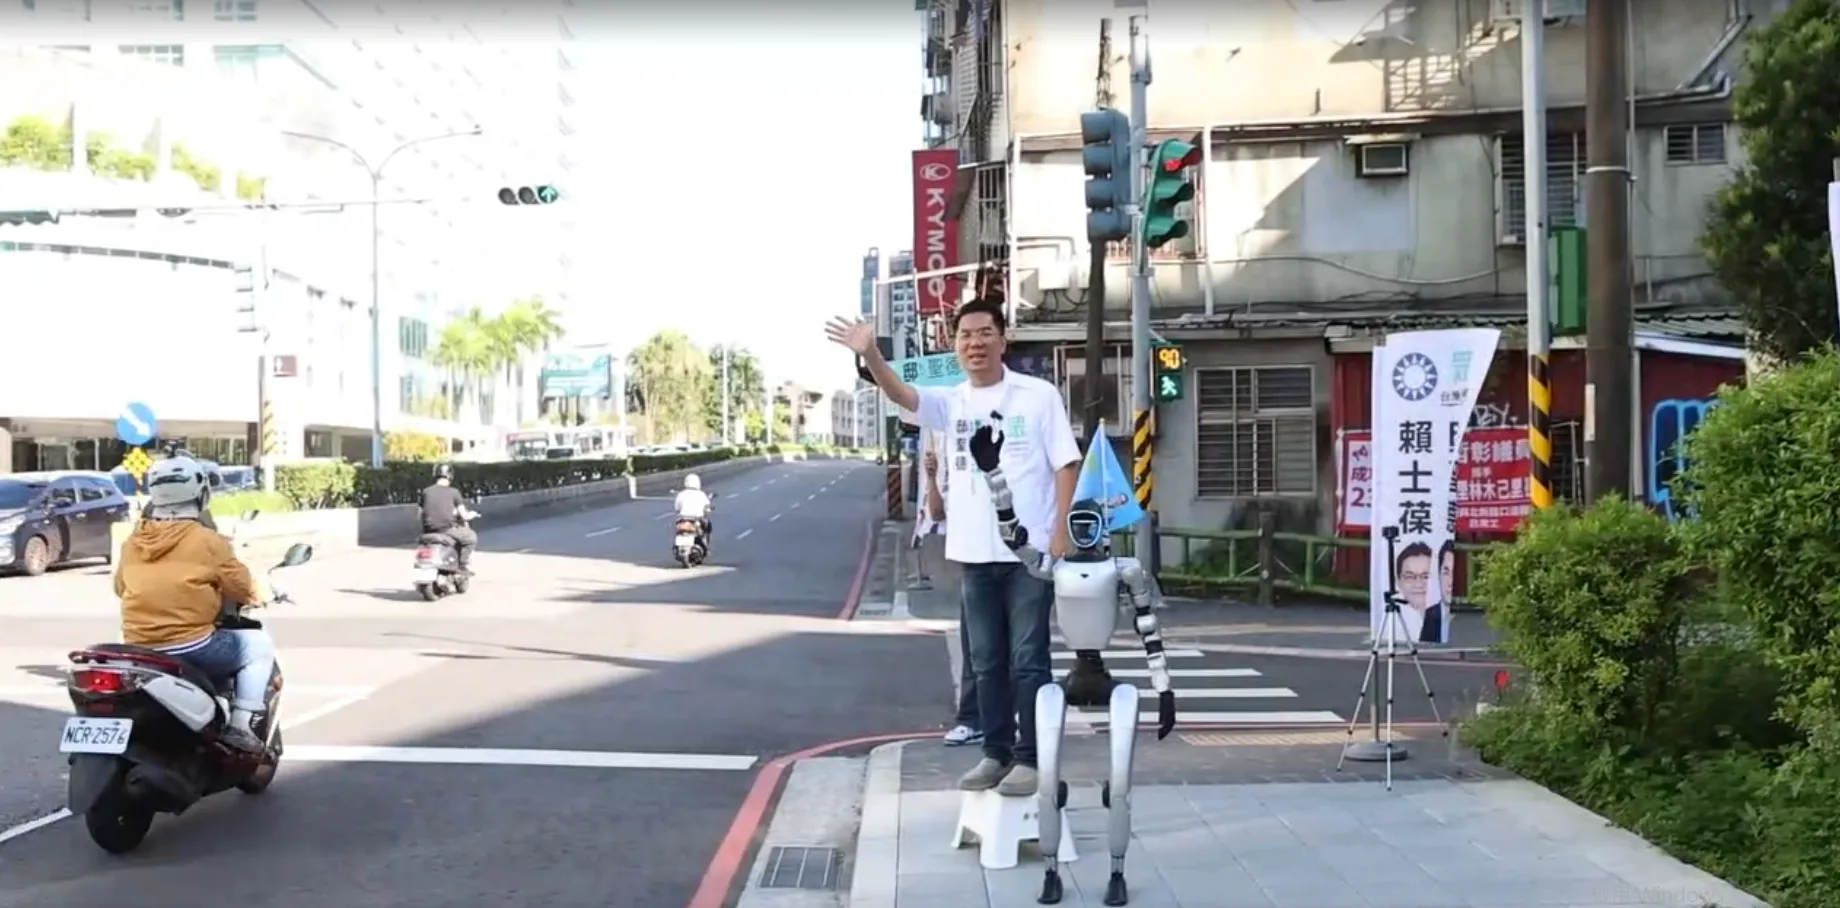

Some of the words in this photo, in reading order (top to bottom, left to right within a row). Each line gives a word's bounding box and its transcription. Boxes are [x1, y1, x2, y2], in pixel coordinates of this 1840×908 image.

[926, 187, 946, 297] KYMCO
[1159, 347, 1180, 370] 90
[1398, 420, 1433, 534] 賴士葆
[64, 726, 128, 745] NCR-2576
